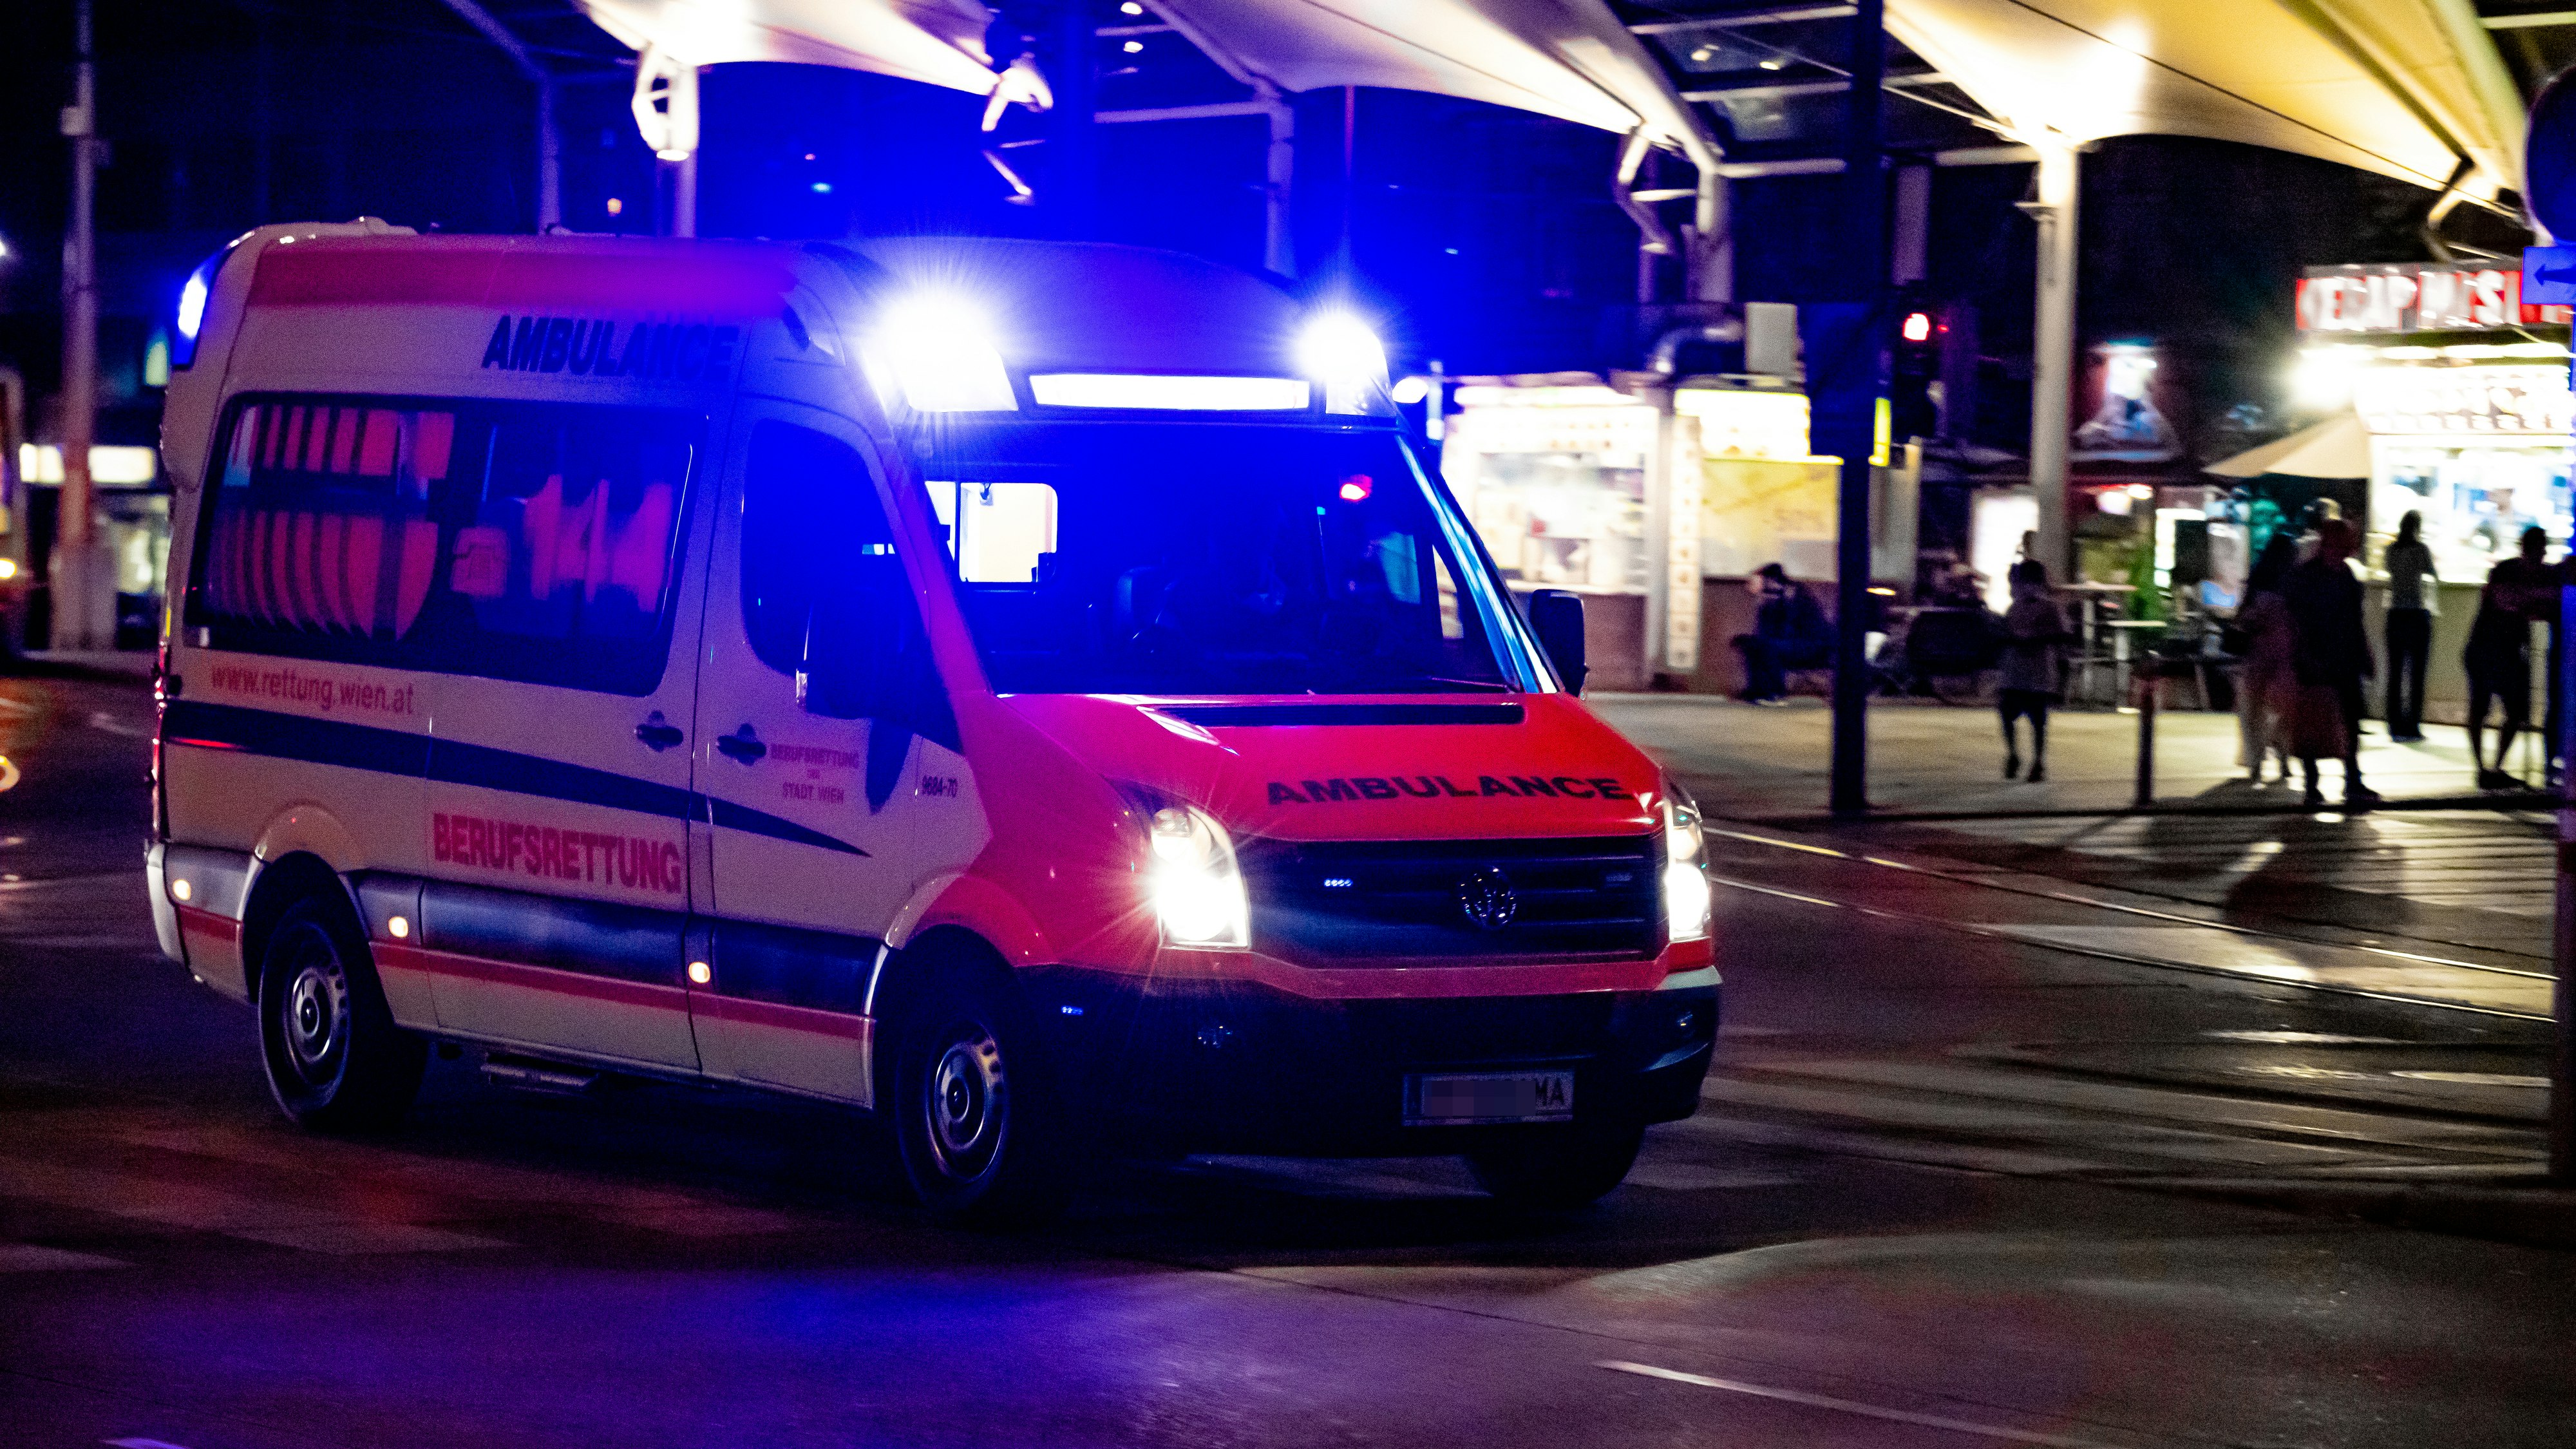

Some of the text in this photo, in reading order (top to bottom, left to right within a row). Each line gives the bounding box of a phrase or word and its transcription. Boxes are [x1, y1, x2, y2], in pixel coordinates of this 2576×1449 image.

[481, 316, 739, 383] AMBULANCE
[211, 666, 413, 715] www.rettung.wien.at
[782, 782, 844, 804] STADT WIEN
[1267, 775, 1634, 805] AMBULANCE
[433, 813, 681, 894] BERUFSRETTUNG
